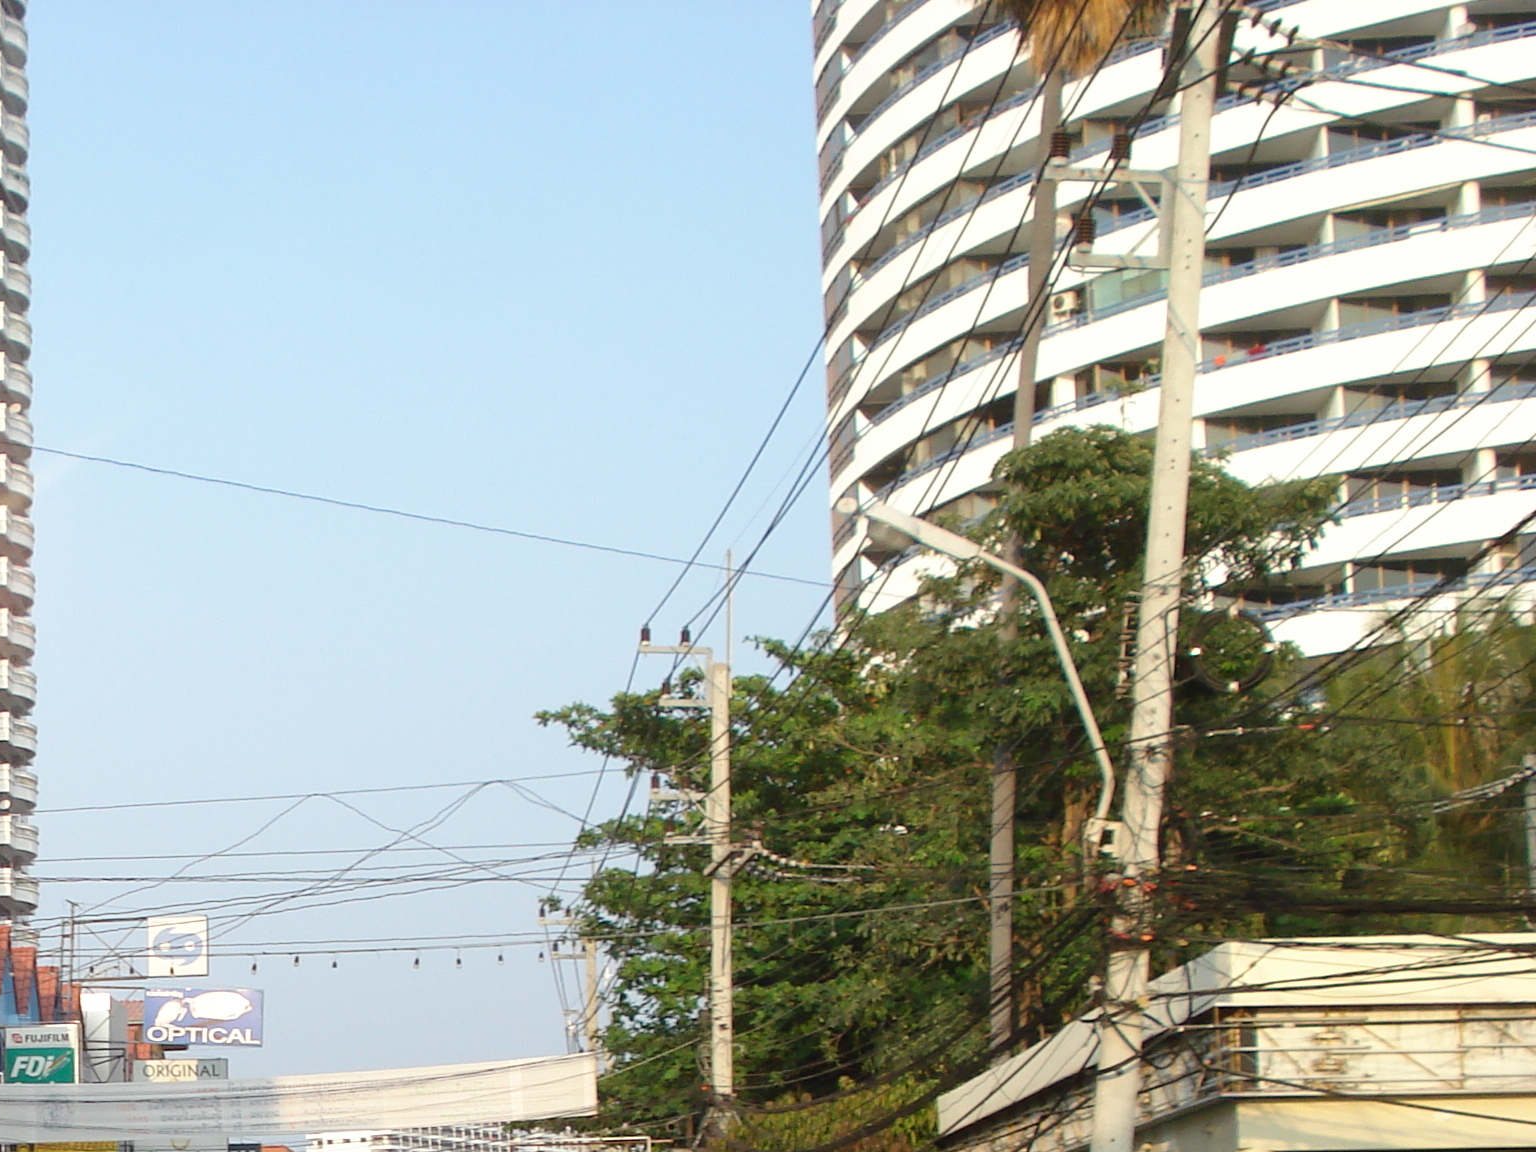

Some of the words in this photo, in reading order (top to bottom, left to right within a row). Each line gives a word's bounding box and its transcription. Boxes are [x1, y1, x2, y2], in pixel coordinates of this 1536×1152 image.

[25, 1033, 69, 1043] FUJIFILM
[147, 1026, 261, 1045] OPTICAL
[142, 1064, 220, 1077] ORIGINAL
